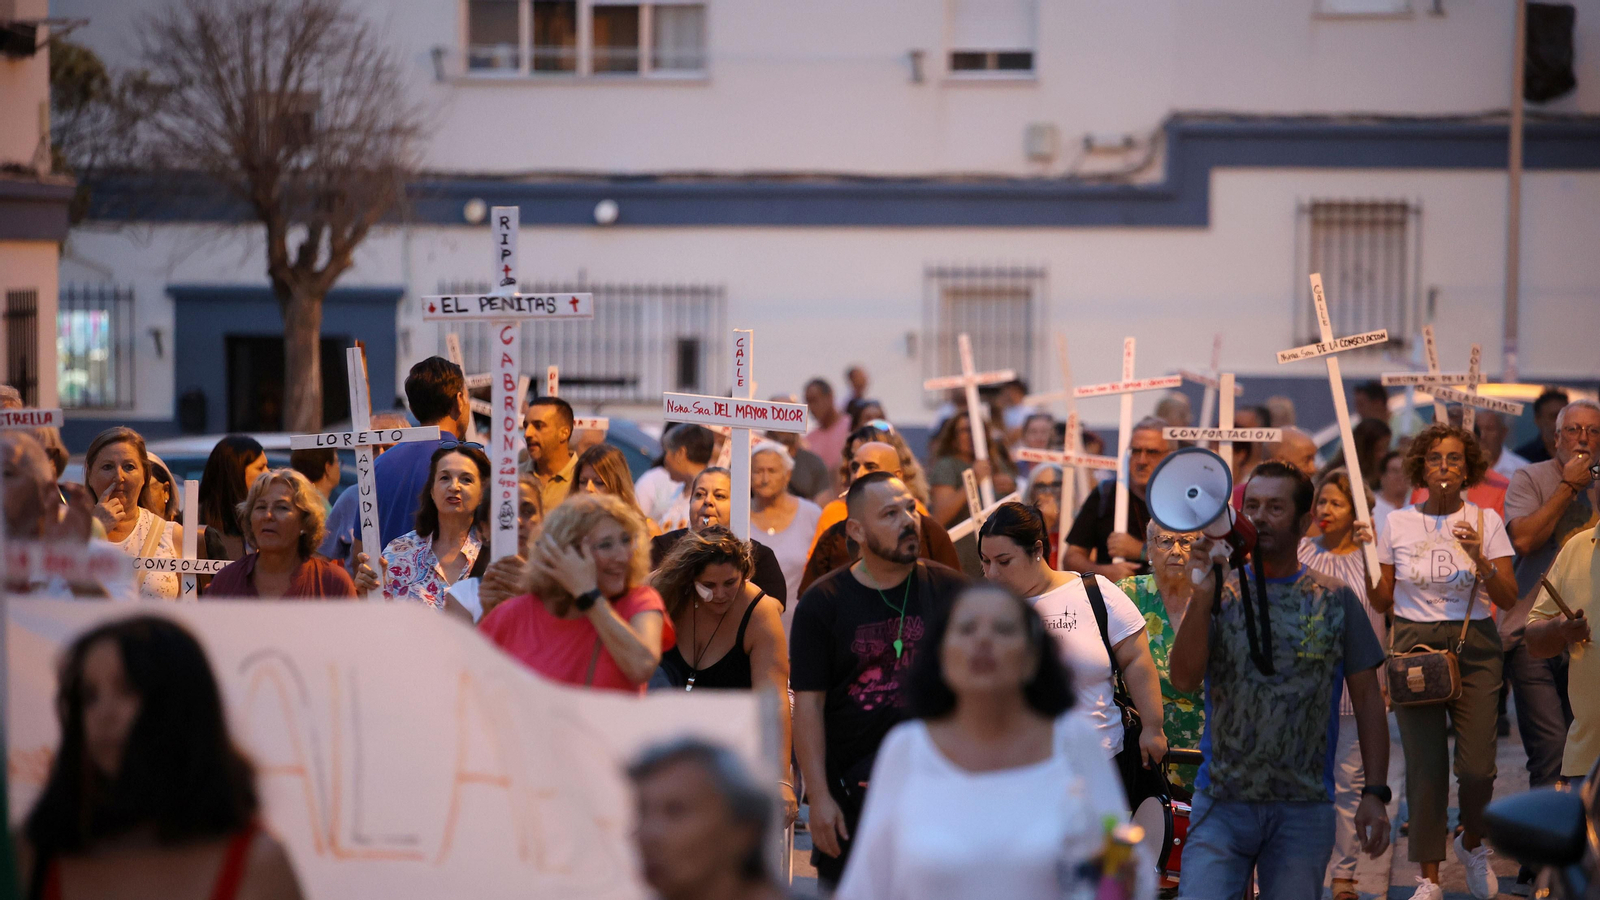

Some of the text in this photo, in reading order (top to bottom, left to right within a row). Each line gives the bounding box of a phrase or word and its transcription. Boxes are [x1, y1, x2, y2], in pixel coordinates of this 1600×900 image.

[499, 216, 511, 262] RIP
[441, 296, 556, 314] EL PENITAS
[735, 338, 745, 387] CALLE
[500, 325, 516, 451] CABRON
[714, 402, 732, 418] DEL
[735, 405, 768, 421] MAYOR
[771, 406, 803, 423] DOLOR
[316, 430, 403, 447] LORETO
[358, 454, 374, 530] AYUDA
[1431, 549, 1459, 584] B
